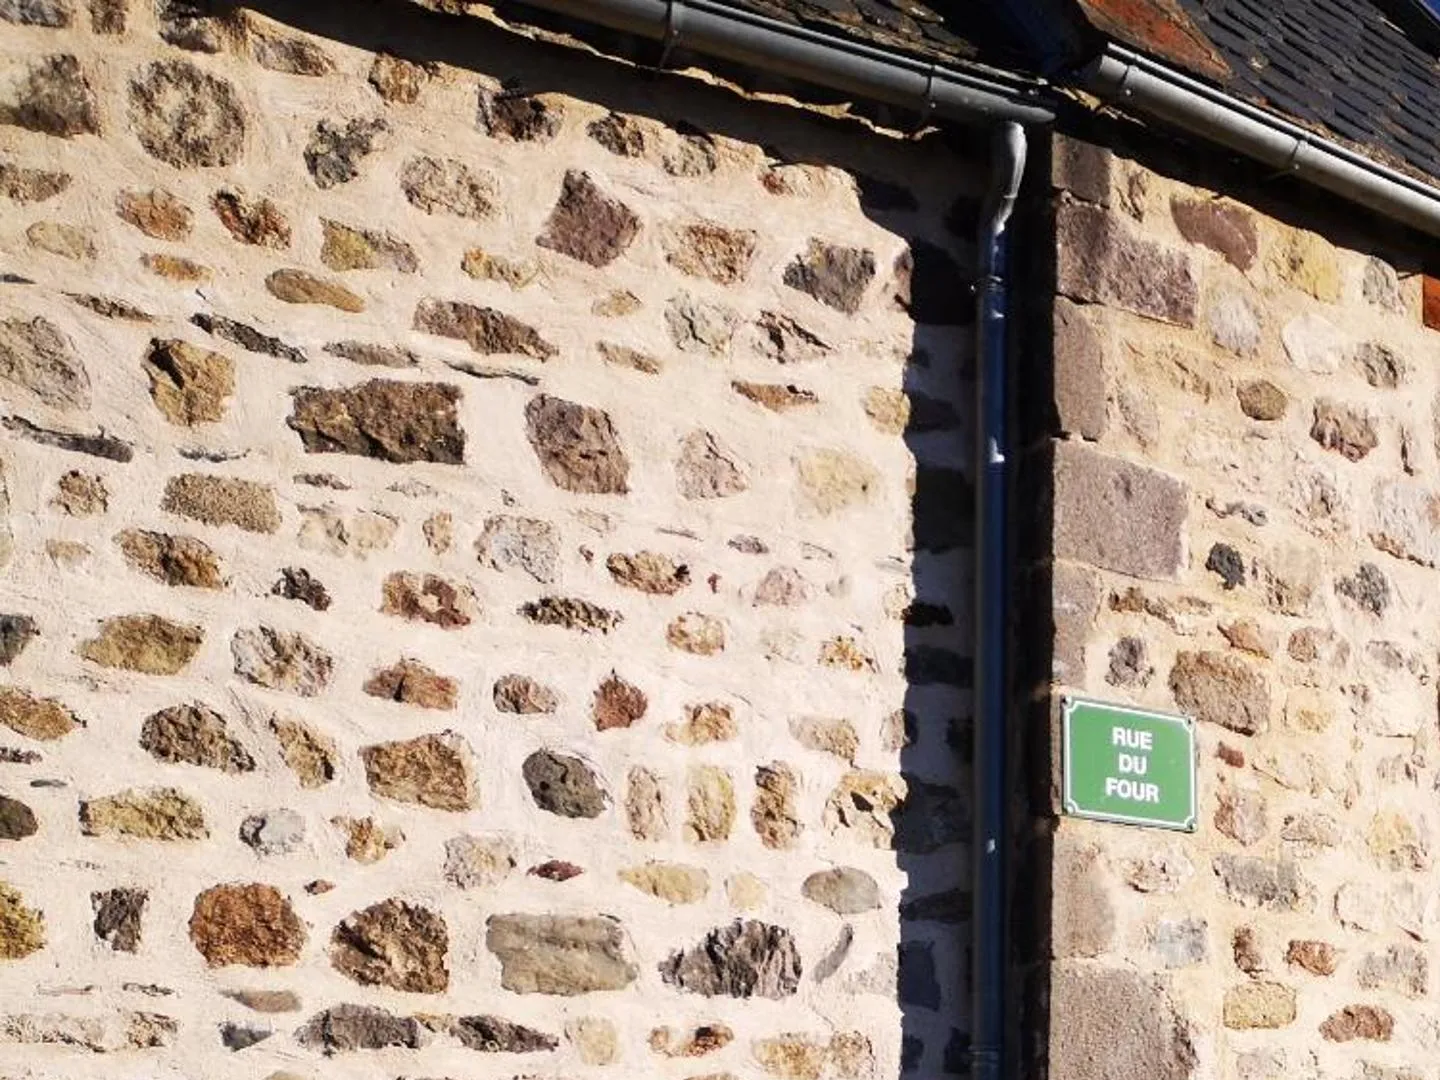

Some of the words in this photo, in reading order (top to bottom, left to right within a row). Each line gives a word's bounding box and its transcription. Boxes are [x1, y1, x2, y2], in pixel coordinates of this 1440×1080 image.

[1112, 727, 1152, 750] RUE
[1118, 752, 1147, 775] DU
[1105, 777, 1159, 803] FOUR
